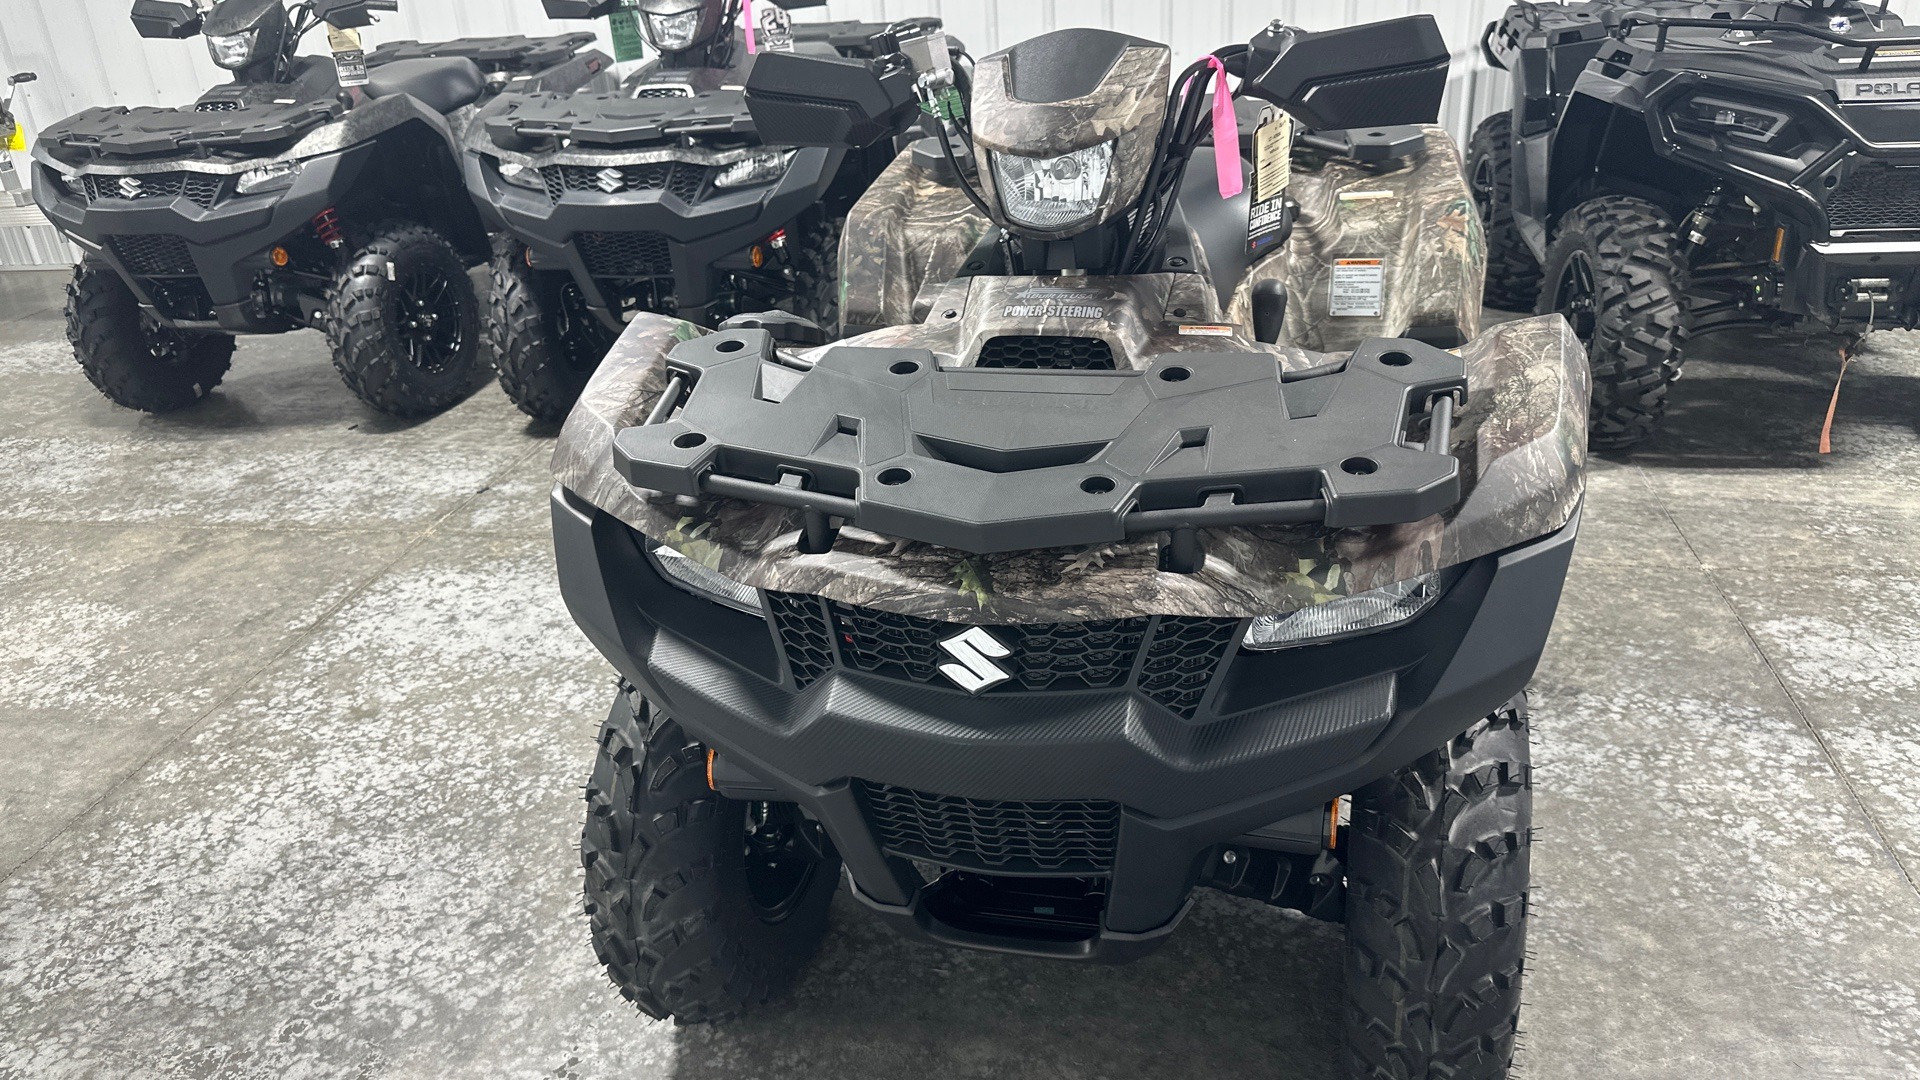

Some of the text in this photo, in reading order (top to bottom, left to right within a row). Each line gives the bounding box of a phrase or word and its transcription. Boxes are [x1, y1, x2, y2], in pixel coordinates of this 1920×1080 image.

[1249, 209, 1282, 231] CONFIDENCE
[1250, 198, 1282, 220] RIDE IN
[1003, 305, 1103, 318] POWER STEERING
